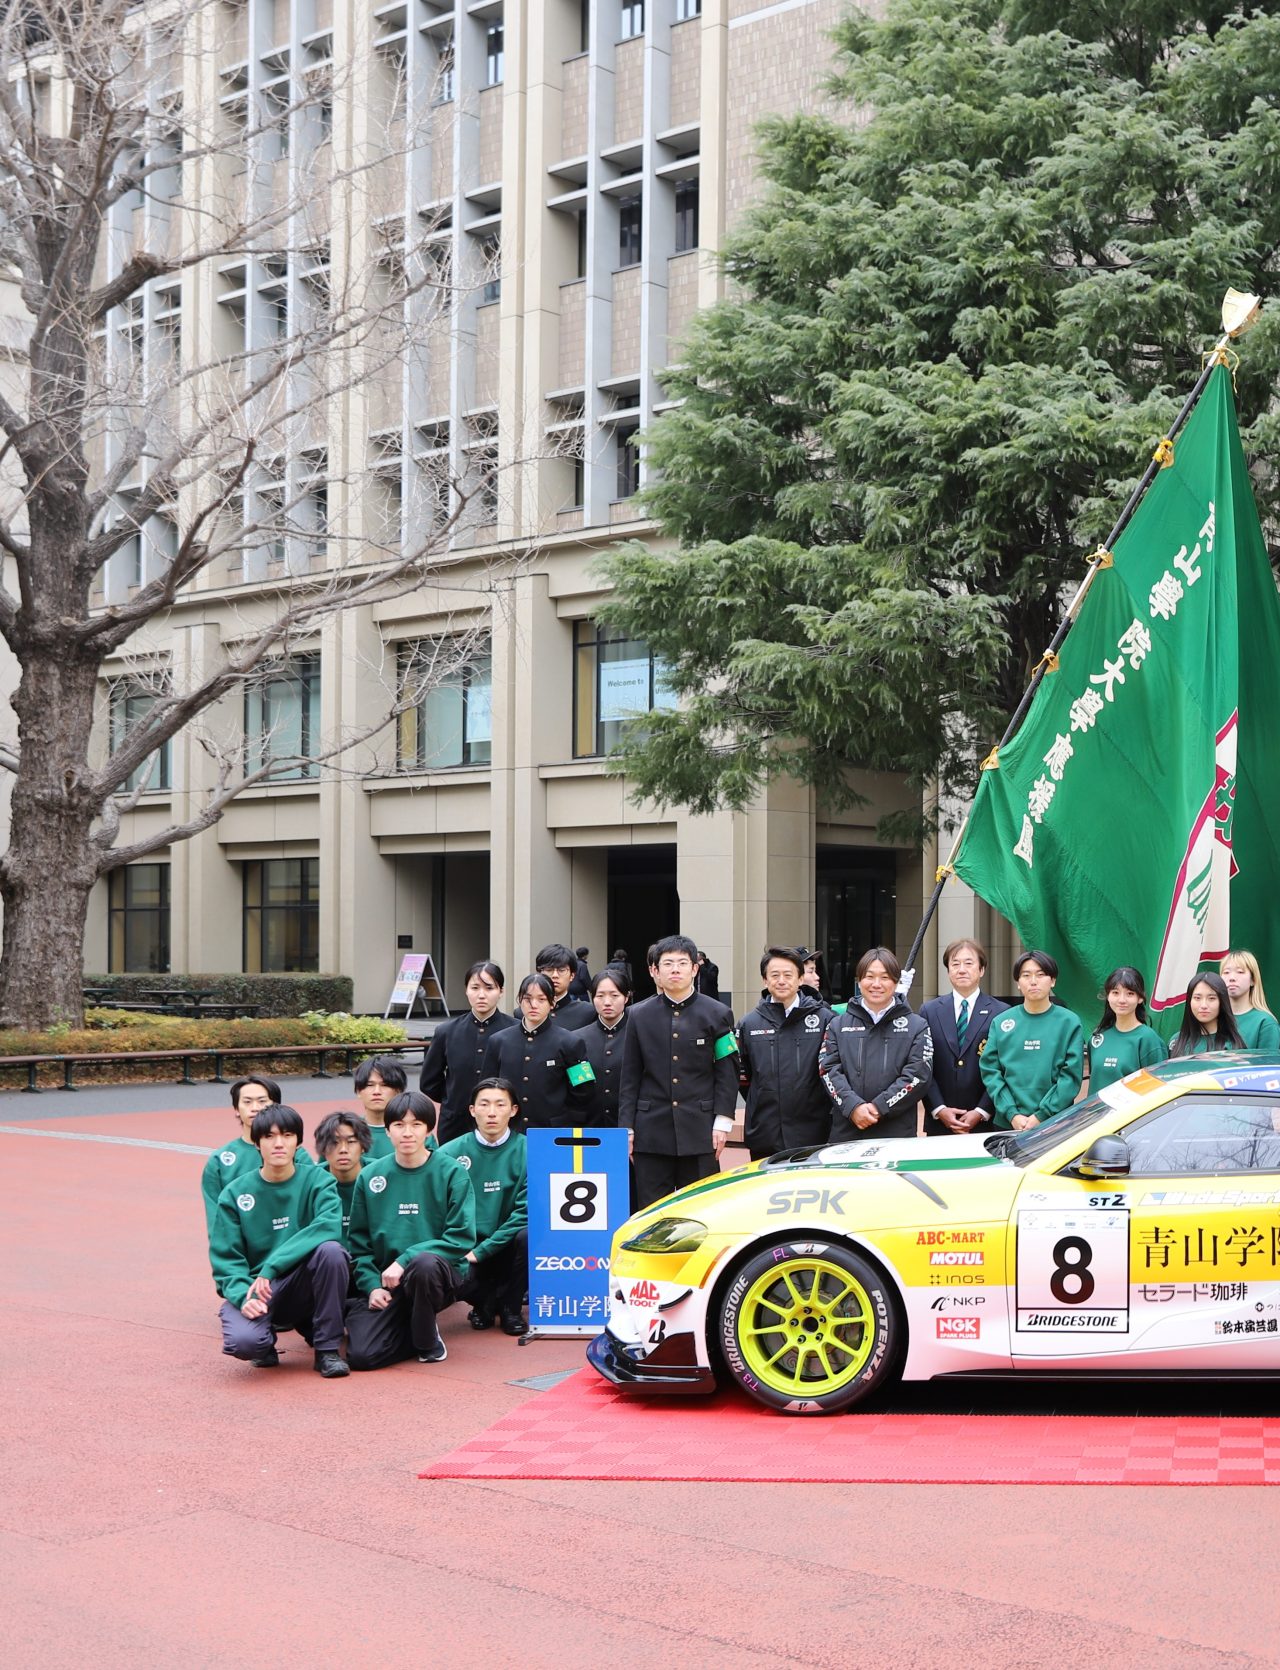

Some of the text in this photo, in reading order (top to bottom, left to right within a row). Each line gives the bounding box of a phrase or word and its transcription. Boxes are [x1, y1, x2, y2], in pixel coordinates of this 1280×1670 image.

[607, 678, 636, 687] Welcome
[559, 1180, 598, 1223] 8
[767, 1189, 849, 1215] SPK
[916, 1231, 985, 1245] ABC-MART
[773, 1248, 790, 1261] FL
[931, 1252, 983, 1264] MOTUL
[1050, 1235, 1095, 1304] 8
[1138, 1283, 1249, 1302] セラード珈琲
[953, 1297, 986, 1306] NKP
[723, 1275, 749, 1373] BRIDGESTONE
[940, 1319, 977, 1332] NGK
[1028, 1314, 1118, 1327] BRIDGESTONE
[862, 1289, 889, 1381] POTENZA
